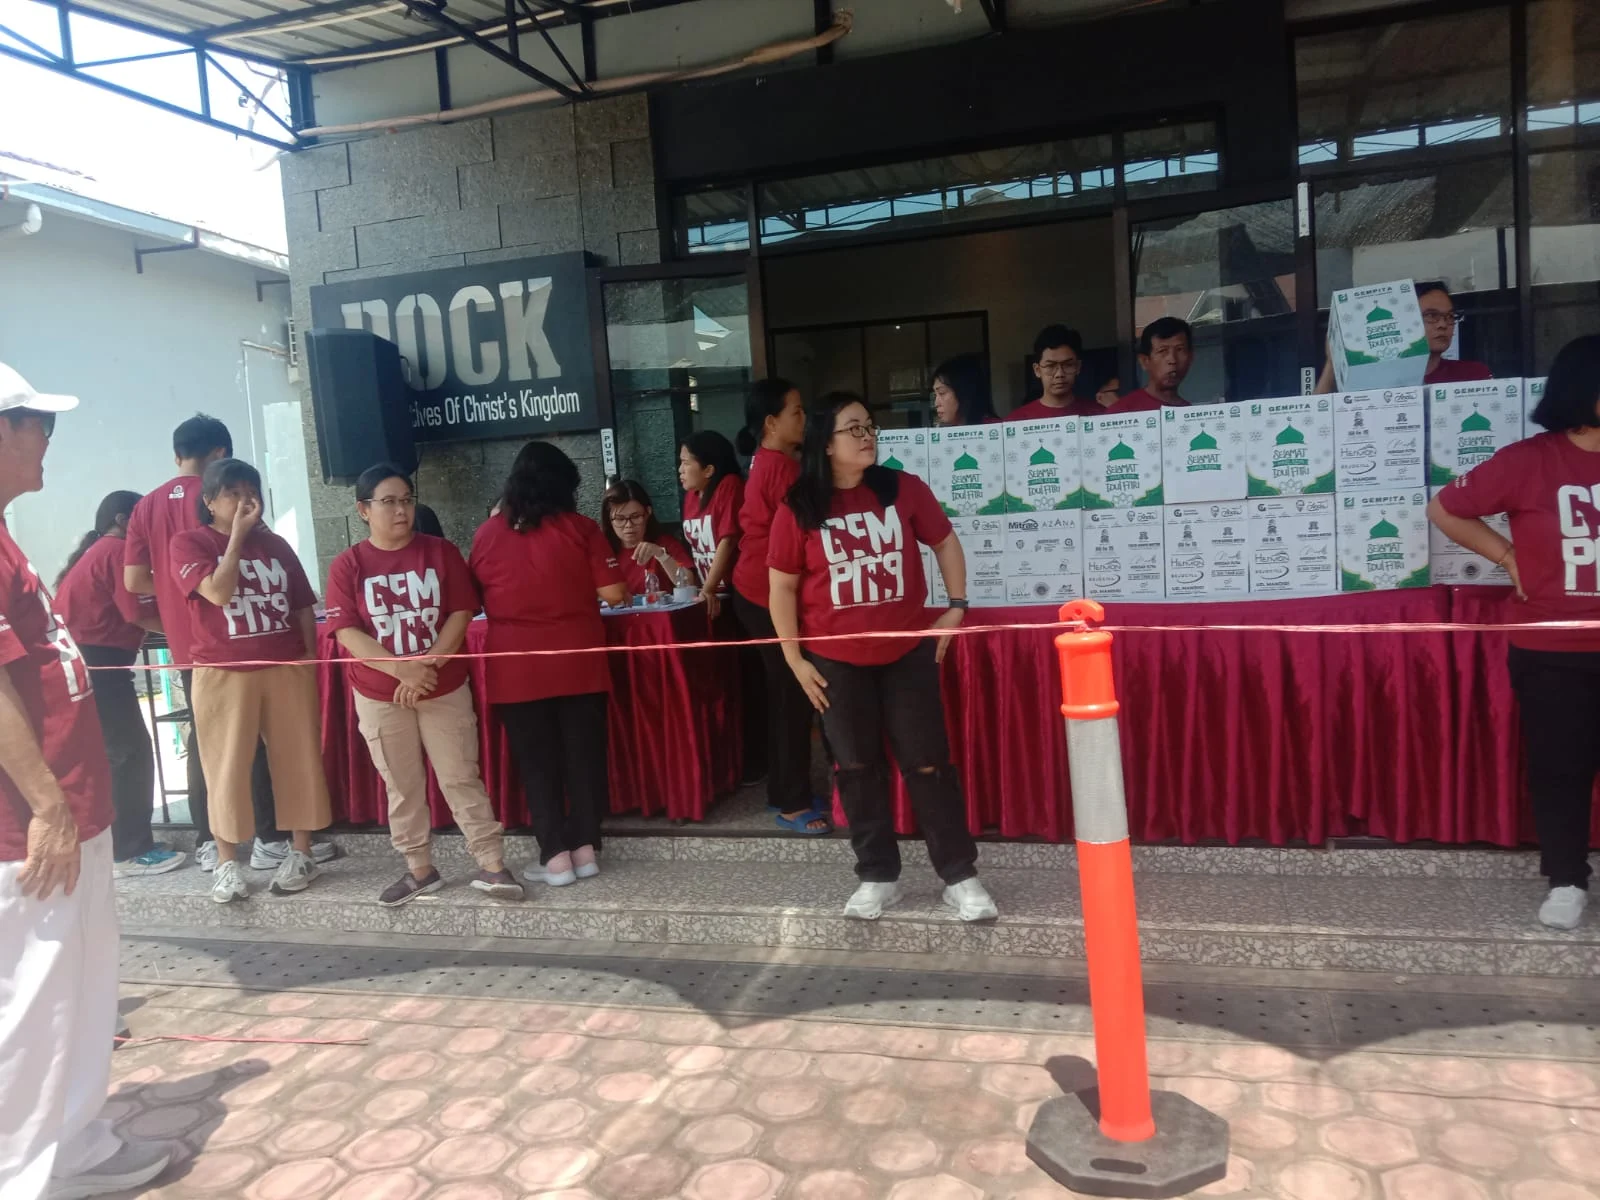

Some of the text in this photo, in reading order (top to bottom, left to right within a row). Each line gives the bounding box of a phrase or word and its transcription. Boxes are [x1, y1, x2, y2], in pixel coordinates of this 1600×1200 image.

[1353, 286, 1393, 297] GEMPITA
[1454, 386, 1498, 395] GEMPITA
[445, 396, 460, 425] Of
[463, 391, 518, 422] Christ's
[520, 386, 580, 421] Kingdom
[1268, 403, 1311, 412] GEMPITA
[1183, 410, 1224, 419] GEMPITA
[1022, 423, 1060, 432] GEMPITA
[1100, 418, 1139, 428] GEMPITA
[947, 430, 984, 438] GEMPITA
[604, 435, 613, 463] PUSH
[1361, 496, 1405, 504] GEMPITA
[218, 556, 288, 595] EM
